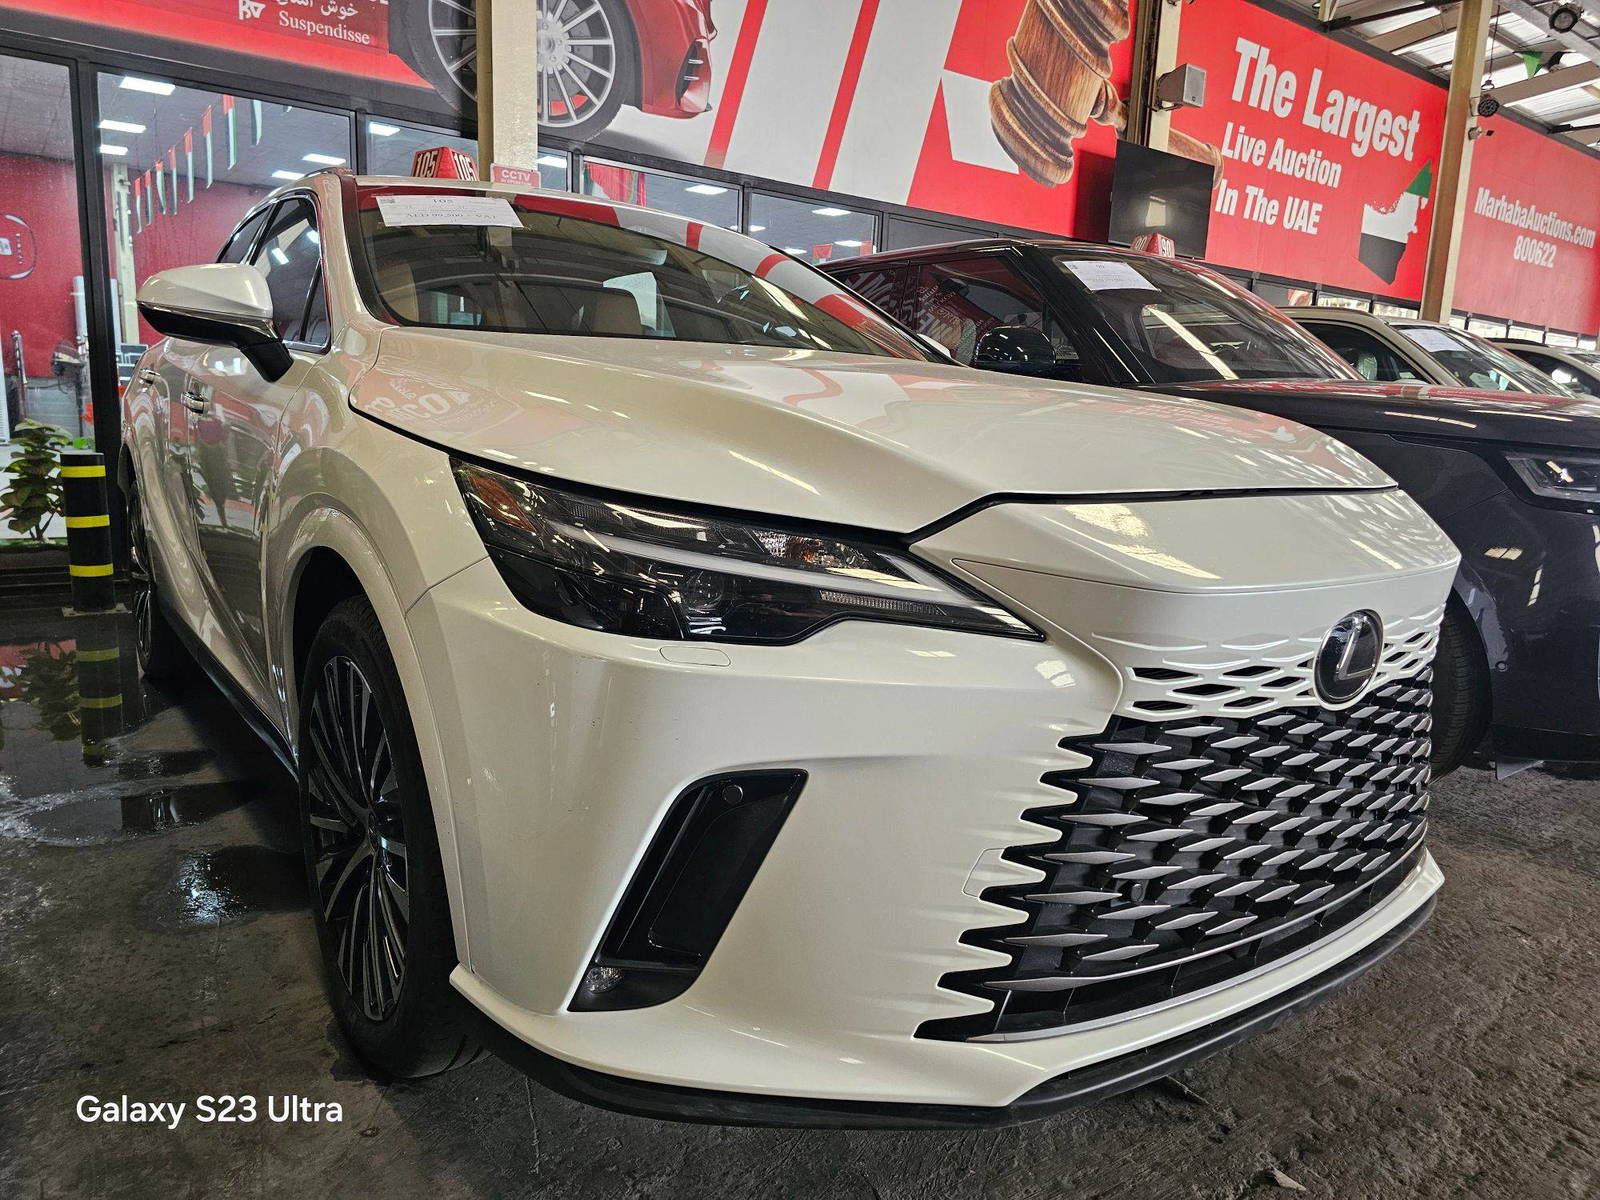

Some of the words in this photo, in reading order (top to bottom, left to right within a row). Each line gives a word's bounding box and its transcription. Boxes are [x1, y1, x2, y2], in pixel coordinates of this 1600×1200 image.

[279, 10, 371, 45] Suspendisse
[1231, 37, 1297, 118] The
[1302, 68, 1421, 161] Largest
[415, 150, 439, 178] 105
[454, 152, 478, 181] 105
[1221, 122, 1267, 166] Live
[1267, 137, 1342, 188] Auction
[501, 169, 531, 182] CCTV
[1215, 178, 1239, 216] In
[1243, 184, 1280, 226] The
[1282, 196, 1323, 235] UAE
[1474, 187, 1597, 249] MarhabaAuctions.com
[1161, 237, 1172, 259] 90
[1513, 235, 1557, 268] 800622
